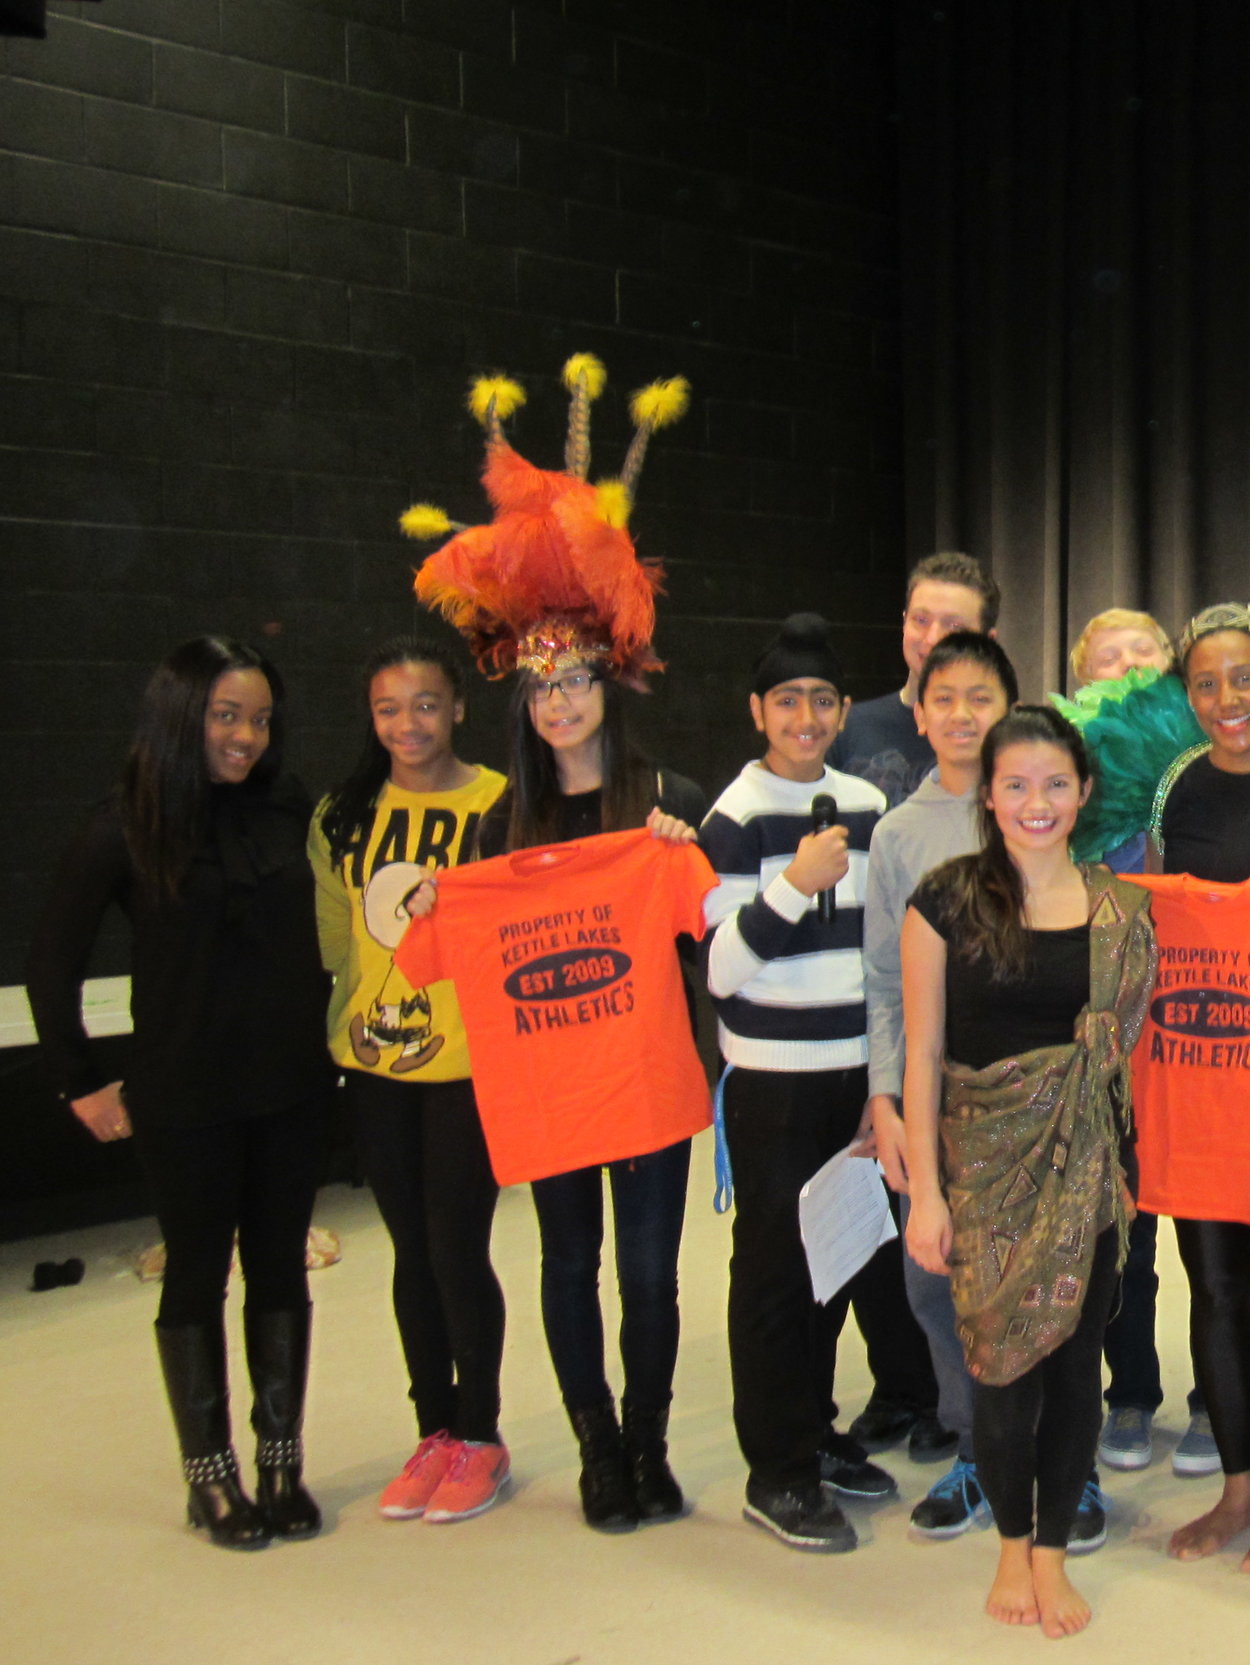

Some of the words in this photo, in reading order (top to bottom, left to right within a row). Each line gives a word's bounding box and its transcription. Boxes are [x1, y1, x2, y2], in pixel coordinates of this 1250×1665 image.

[499, 909, 584, 943] PROPERTY
[592, 904, 612, 923] OF
[502, 933, 559, 968] KETTLE
[565, 927, 621, 944] LAKES
[1158, 946, 1241, 966] PROPERTY
[519, 969, 555, 996] EST
[562, 954, 616, 987] 2009
[1155, 968, 1211, 989] KETTLE
[515, 981, 634, 1035] ATHLETICS
[1163, 1002, 1200, 1026] EST
